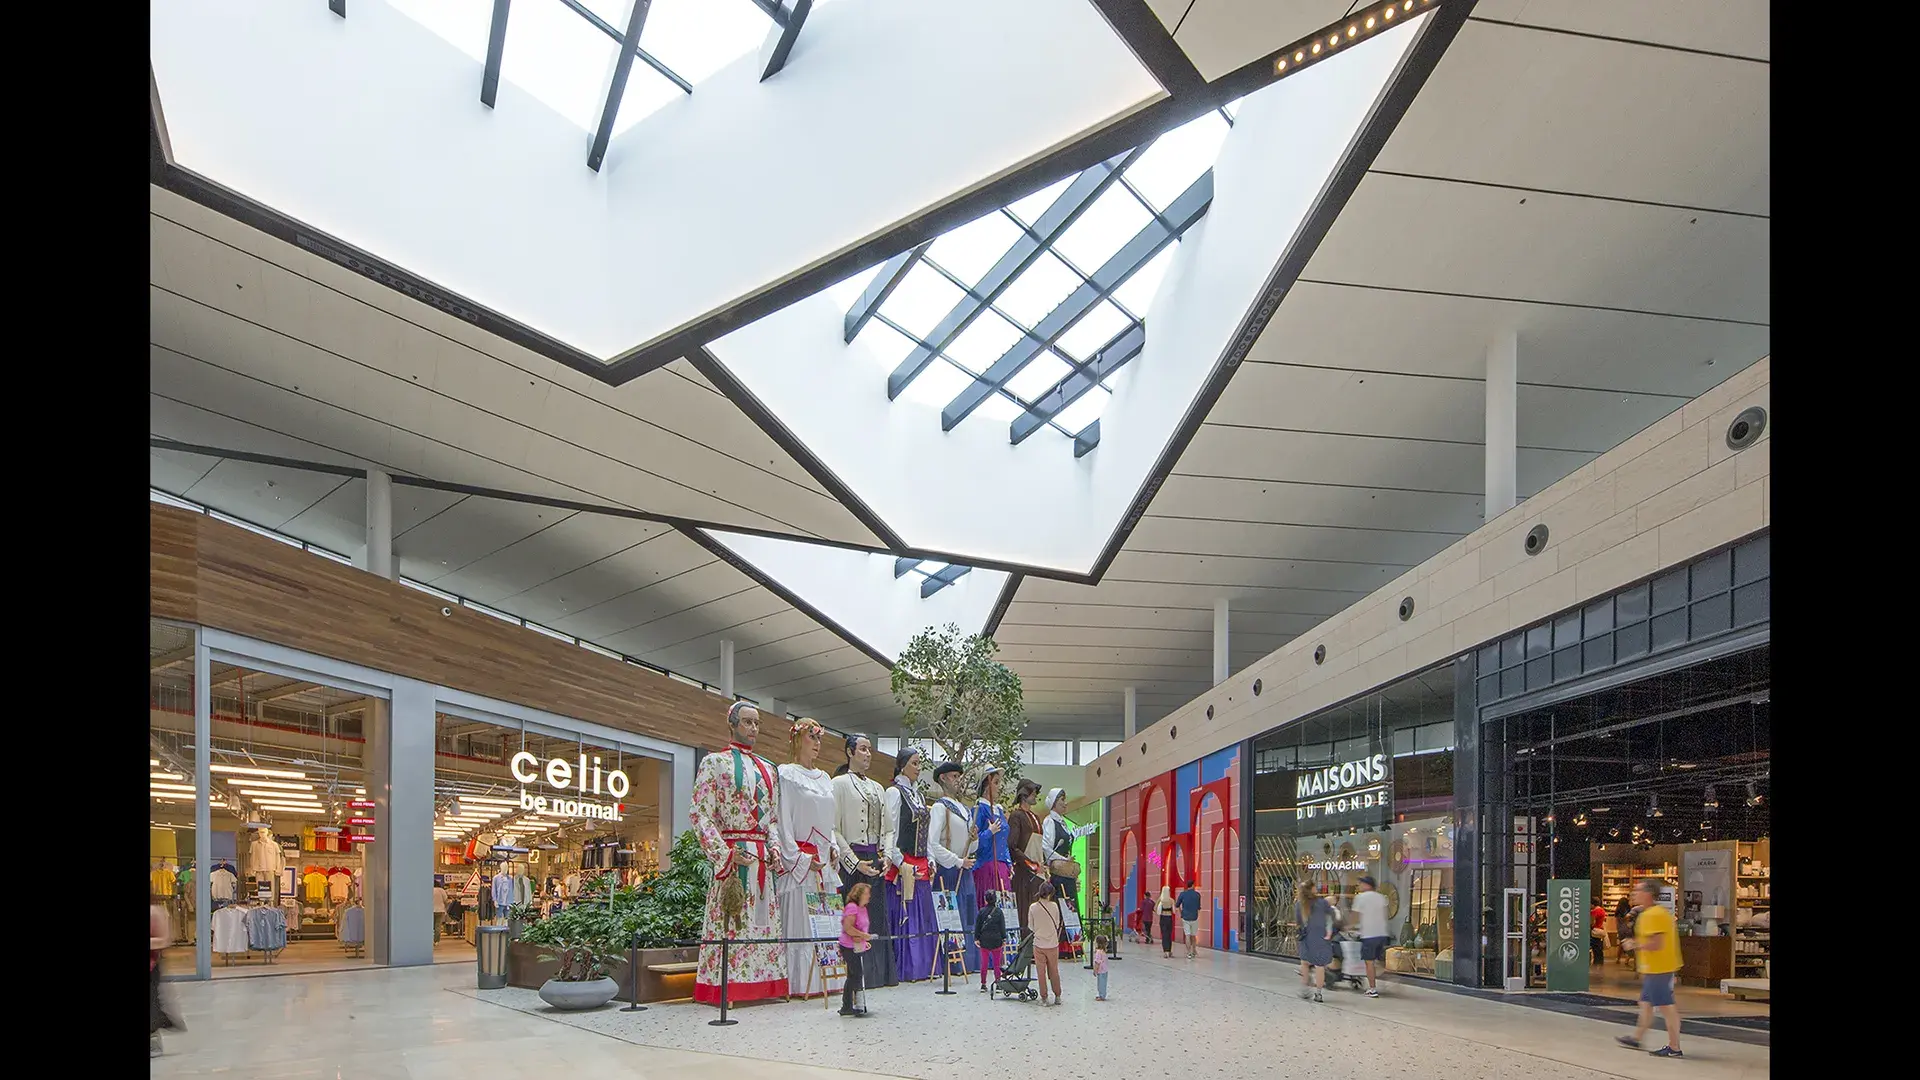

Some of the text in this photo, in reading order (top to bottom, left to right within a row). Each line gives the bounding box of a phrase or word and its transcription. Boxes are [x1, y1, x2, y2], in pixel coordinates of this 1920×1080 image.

[511, 751, 629, 798] celio
[1296, 753, 1385, 799] MAISONS
[520, 788, 548, 812] be
[1296, 791, 1385, 820] DU MONDE
[1559, 886, 1573, 940] GOOD
